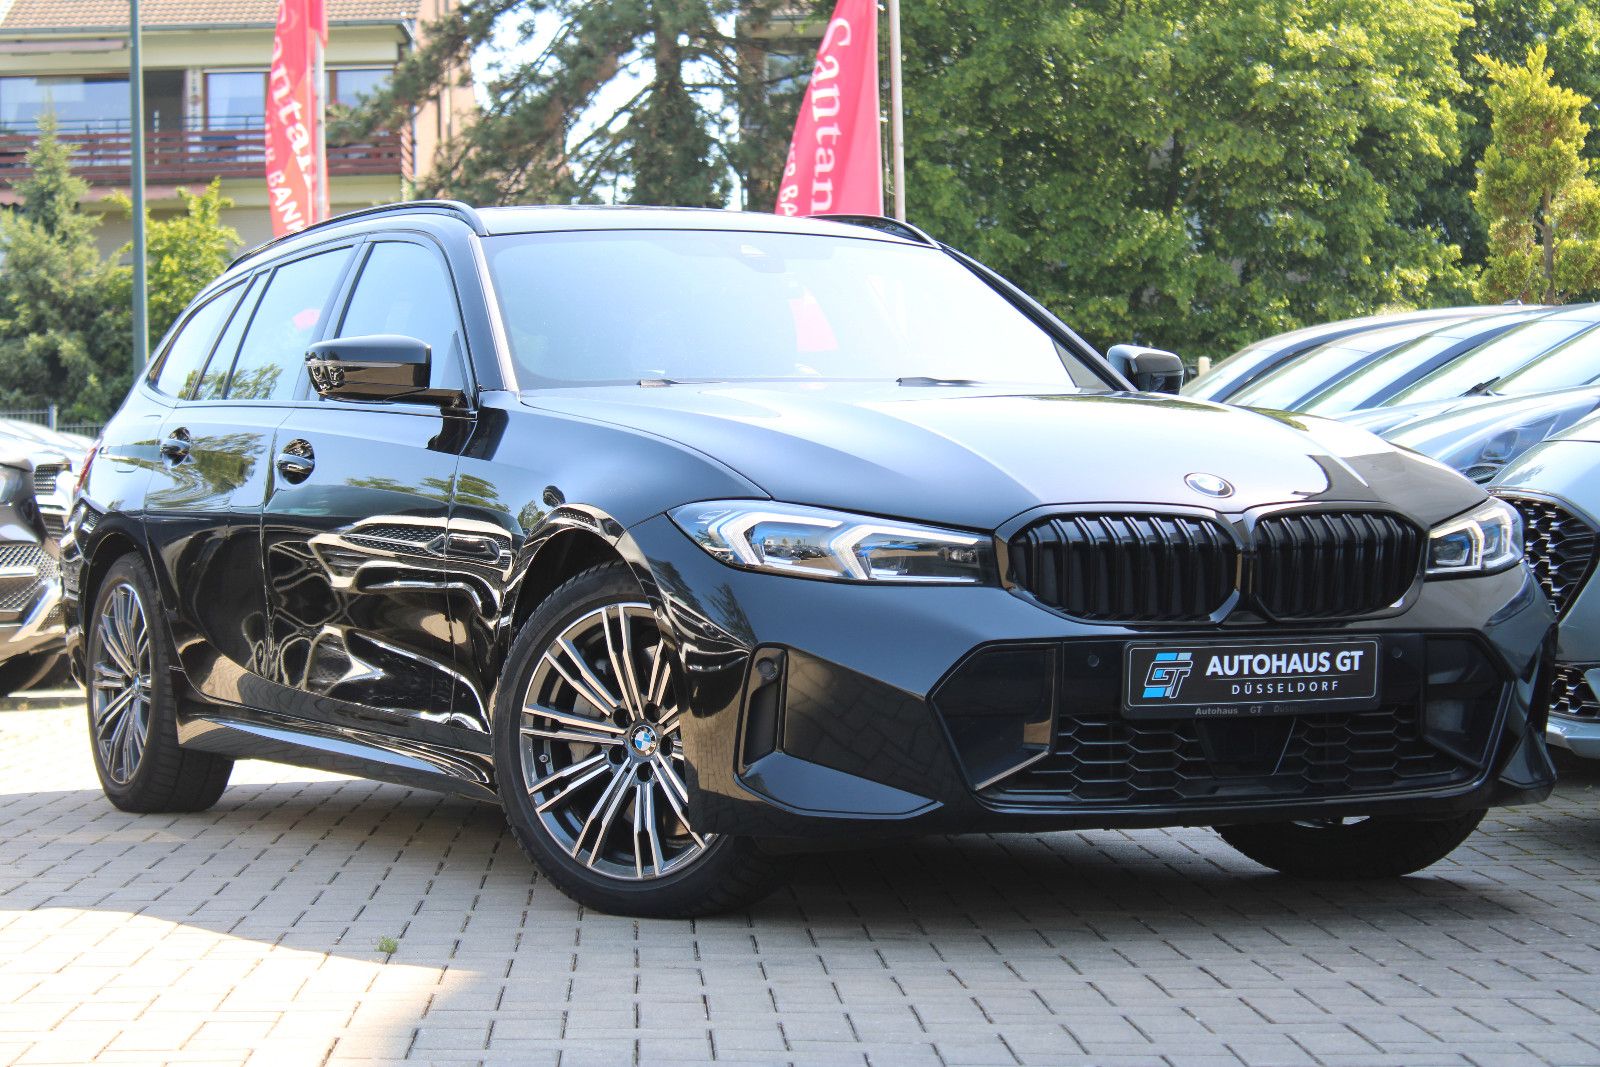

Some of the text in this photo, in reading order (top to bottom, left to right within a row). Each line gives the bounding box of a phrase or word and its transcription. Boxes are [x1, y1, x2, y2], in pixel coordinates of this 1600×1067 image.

[1206, 650, 1363, 676] AUTOHAUS GT
[1231, 680, 1339, 695] DÜSSELDORF
[1195, 706, 1262, 715] Autohaus GT
